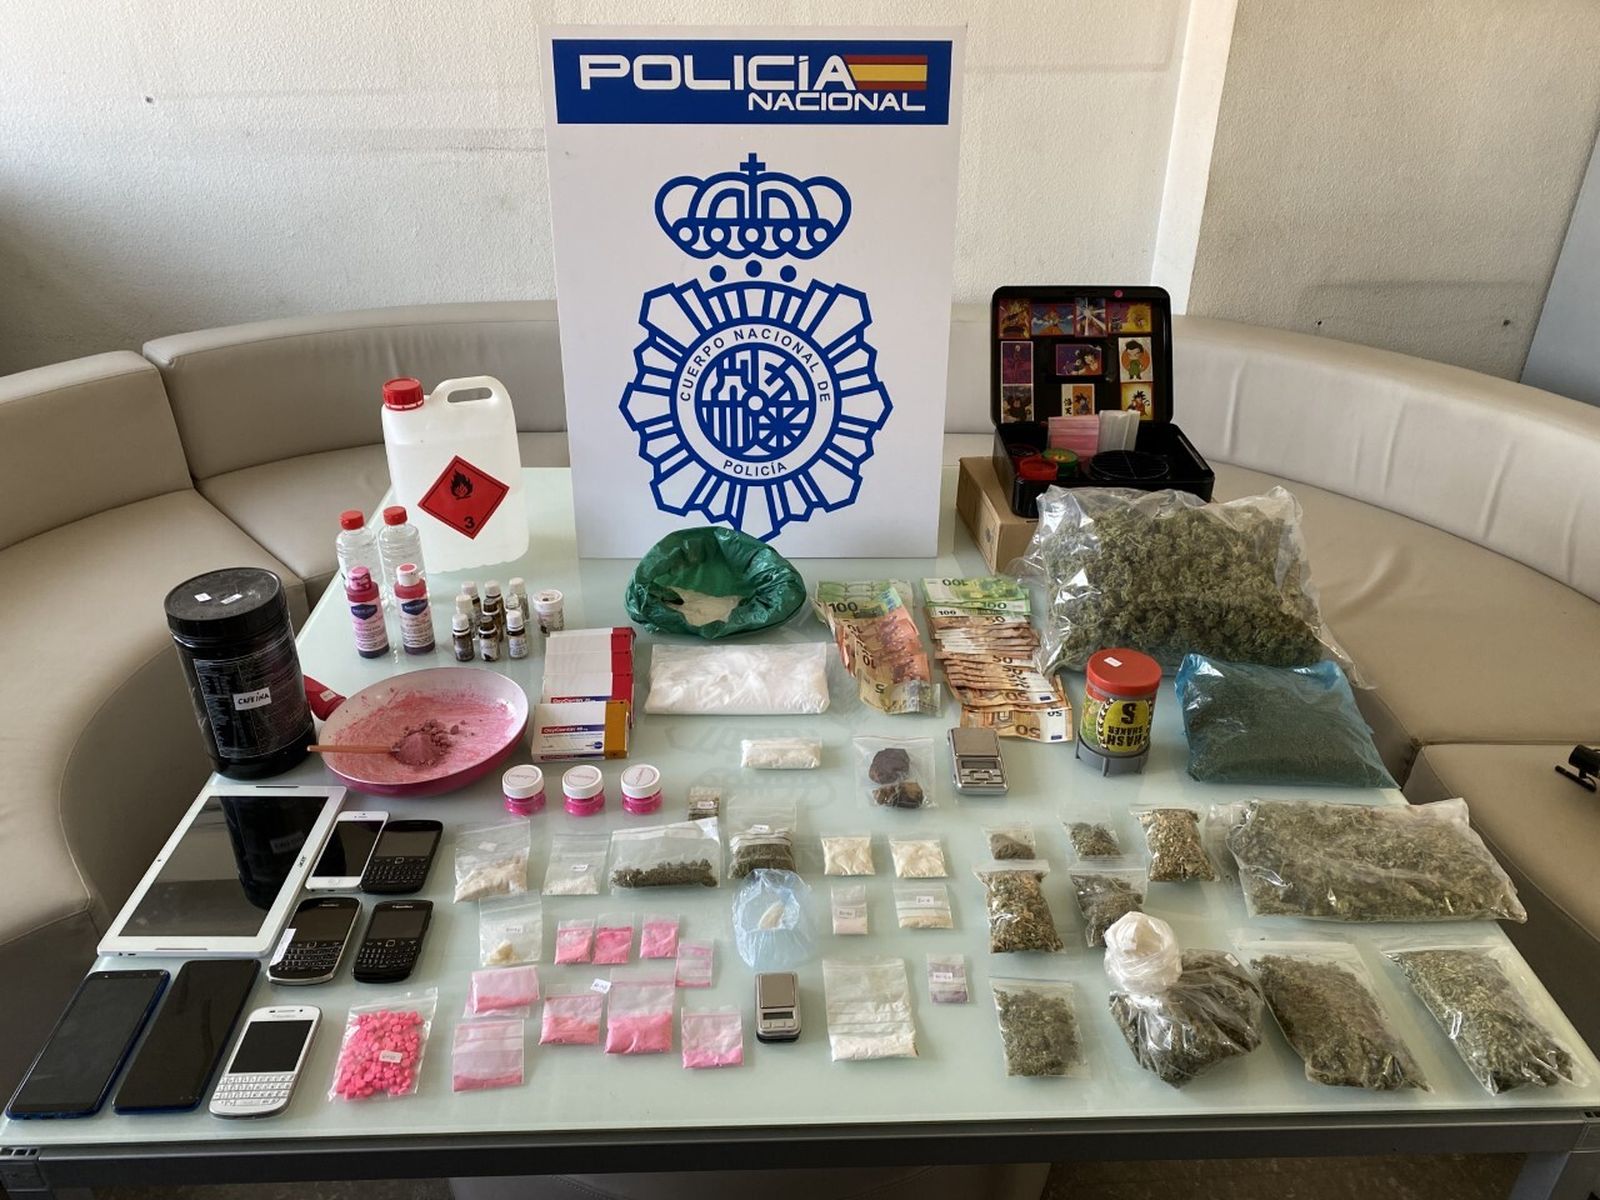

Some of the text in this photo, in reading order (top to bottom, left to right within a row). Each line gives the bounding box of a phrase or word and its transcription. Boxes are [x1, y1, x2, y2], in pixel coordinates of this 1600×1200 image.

[579, 54, 856, 90] POLICÍA
[748, 92, 926, 111] NACIONAL
[680, 328, 831, 402] CUERPO NACIONAL DE
[722, 459, 787, 477] POLICÍA
[464, 515, 475, 529] 3
[828, 601, 858, 613] 100
[862, 654, 877, 669] 10
[874, 683, 885, 694] 5
[1015, 725, 1041, 737] 50
[1108, 726, 1143, 735] SHAKER
[1107, 735, 1142, 746] HASH
